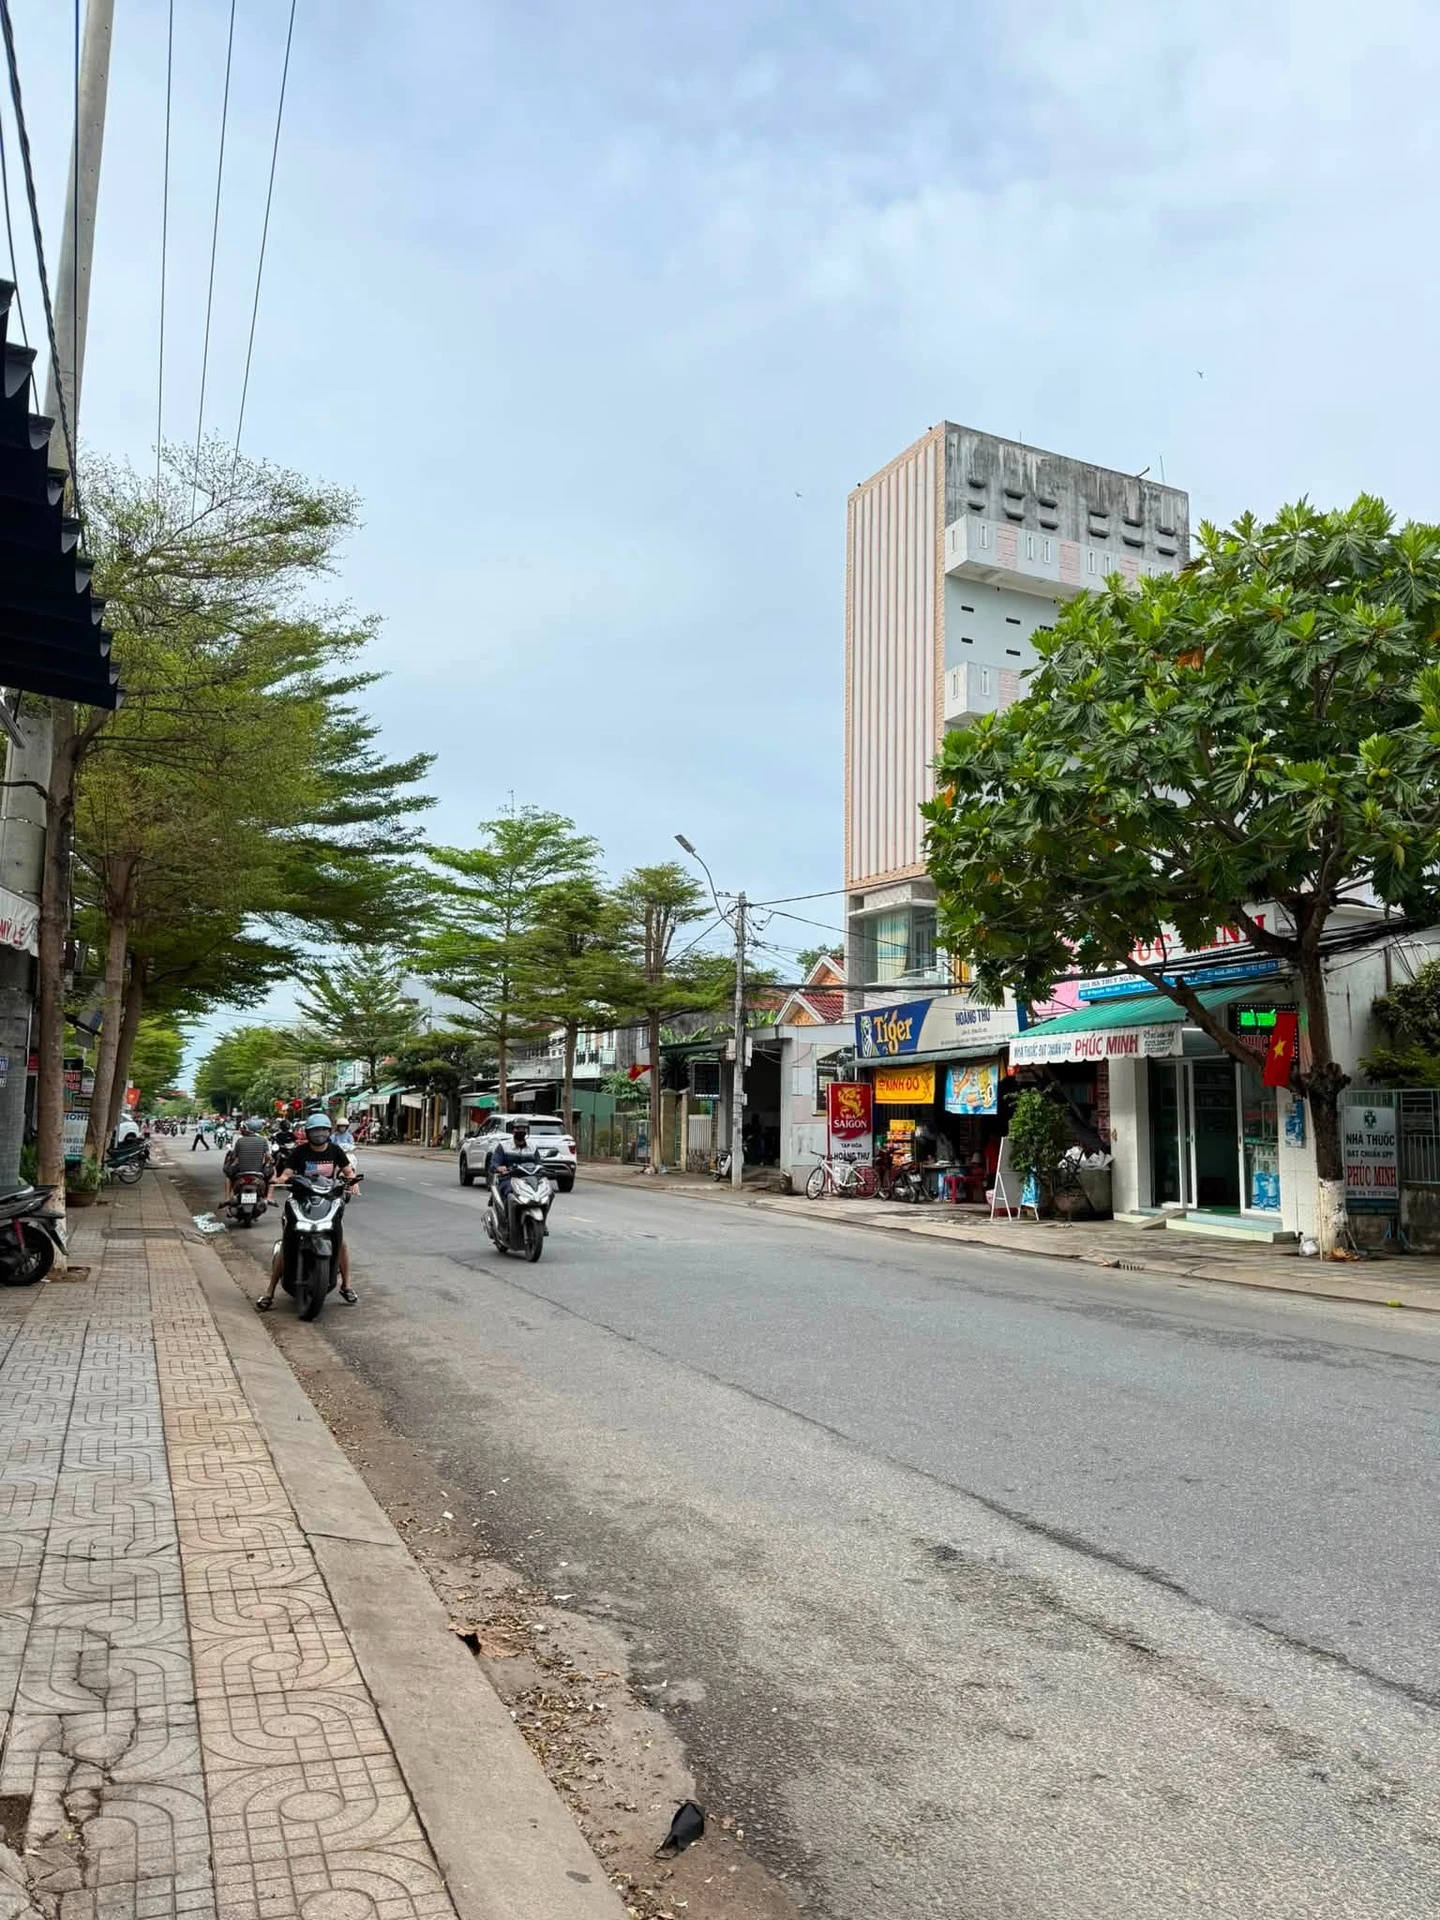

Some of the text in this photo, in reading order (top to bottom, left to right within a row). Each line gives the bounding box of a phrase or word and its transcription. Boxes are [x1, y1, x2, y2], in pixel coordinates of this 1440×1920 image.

[873, 1009, 913, 1055] Tiger
[1074, 1033, 1103, 1057] PHÚC
[1105, 1034, 1139, 1055] MINH
[833, 1119, 867, 1128] SAIGON
[1346, 1130, 1396, 1146] NHÀ THUỐC
[1346, 1161, 1397, 1187] PHÚC MINH
